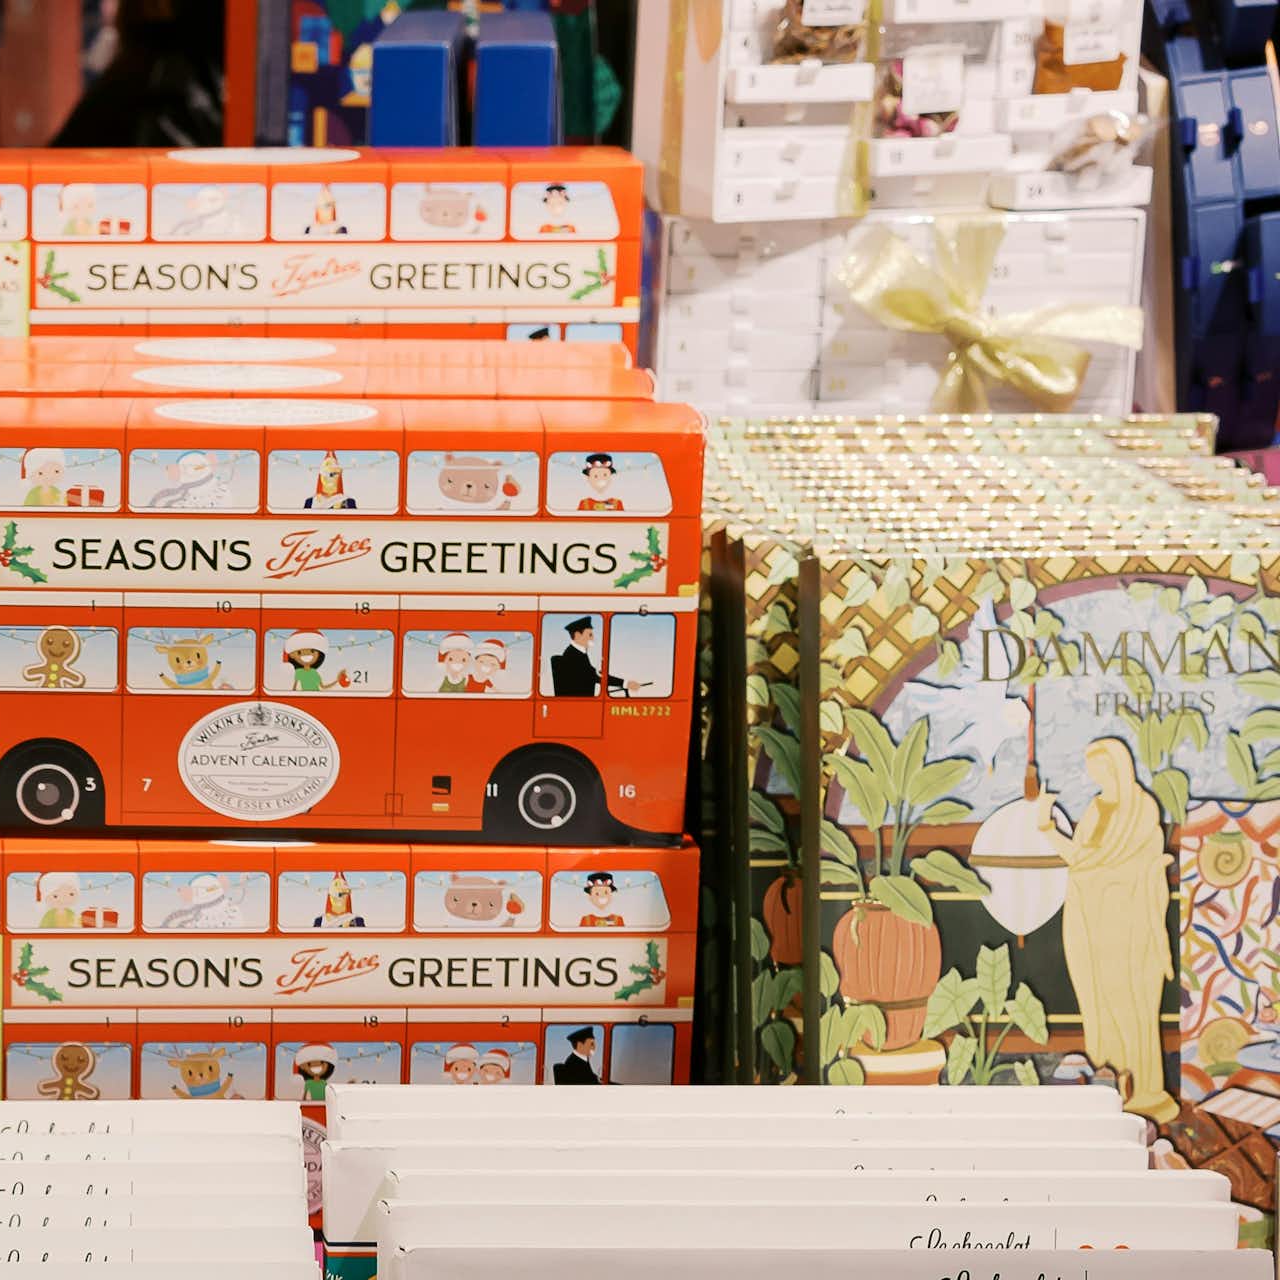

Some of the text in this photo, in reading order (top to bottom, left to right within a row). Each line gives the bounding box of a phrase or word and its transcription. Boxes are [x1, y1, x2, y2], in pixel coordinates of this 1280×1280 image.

[88, 254, 571, 298] SEASON'S Tiptree GREETINGS
[53, 530, 617, 579] SEASON'S Tiptree GREETINGS
[217, 601, 232, 613] 10
[354, 602, 370, 615] 18
[497, 603, 505, 616] 2
[352, 671, 369, 683] 21
[196, 713, 322, 746] WILKIN & SONS LTD
[191, 754, 327, 768] ADVENT CALENDAR
[85, 778, 96, 791] 3
[142, 778, 152, 791] 7
[486, 783, 498, 797] 11
[619, 784, 636, 798] 16
[68, 948, 617, 995] SEASON'S Tiptree GREETINGS
[228, 1016, 243, 1027] 10
[364, 1016, 378, 1027] 18
